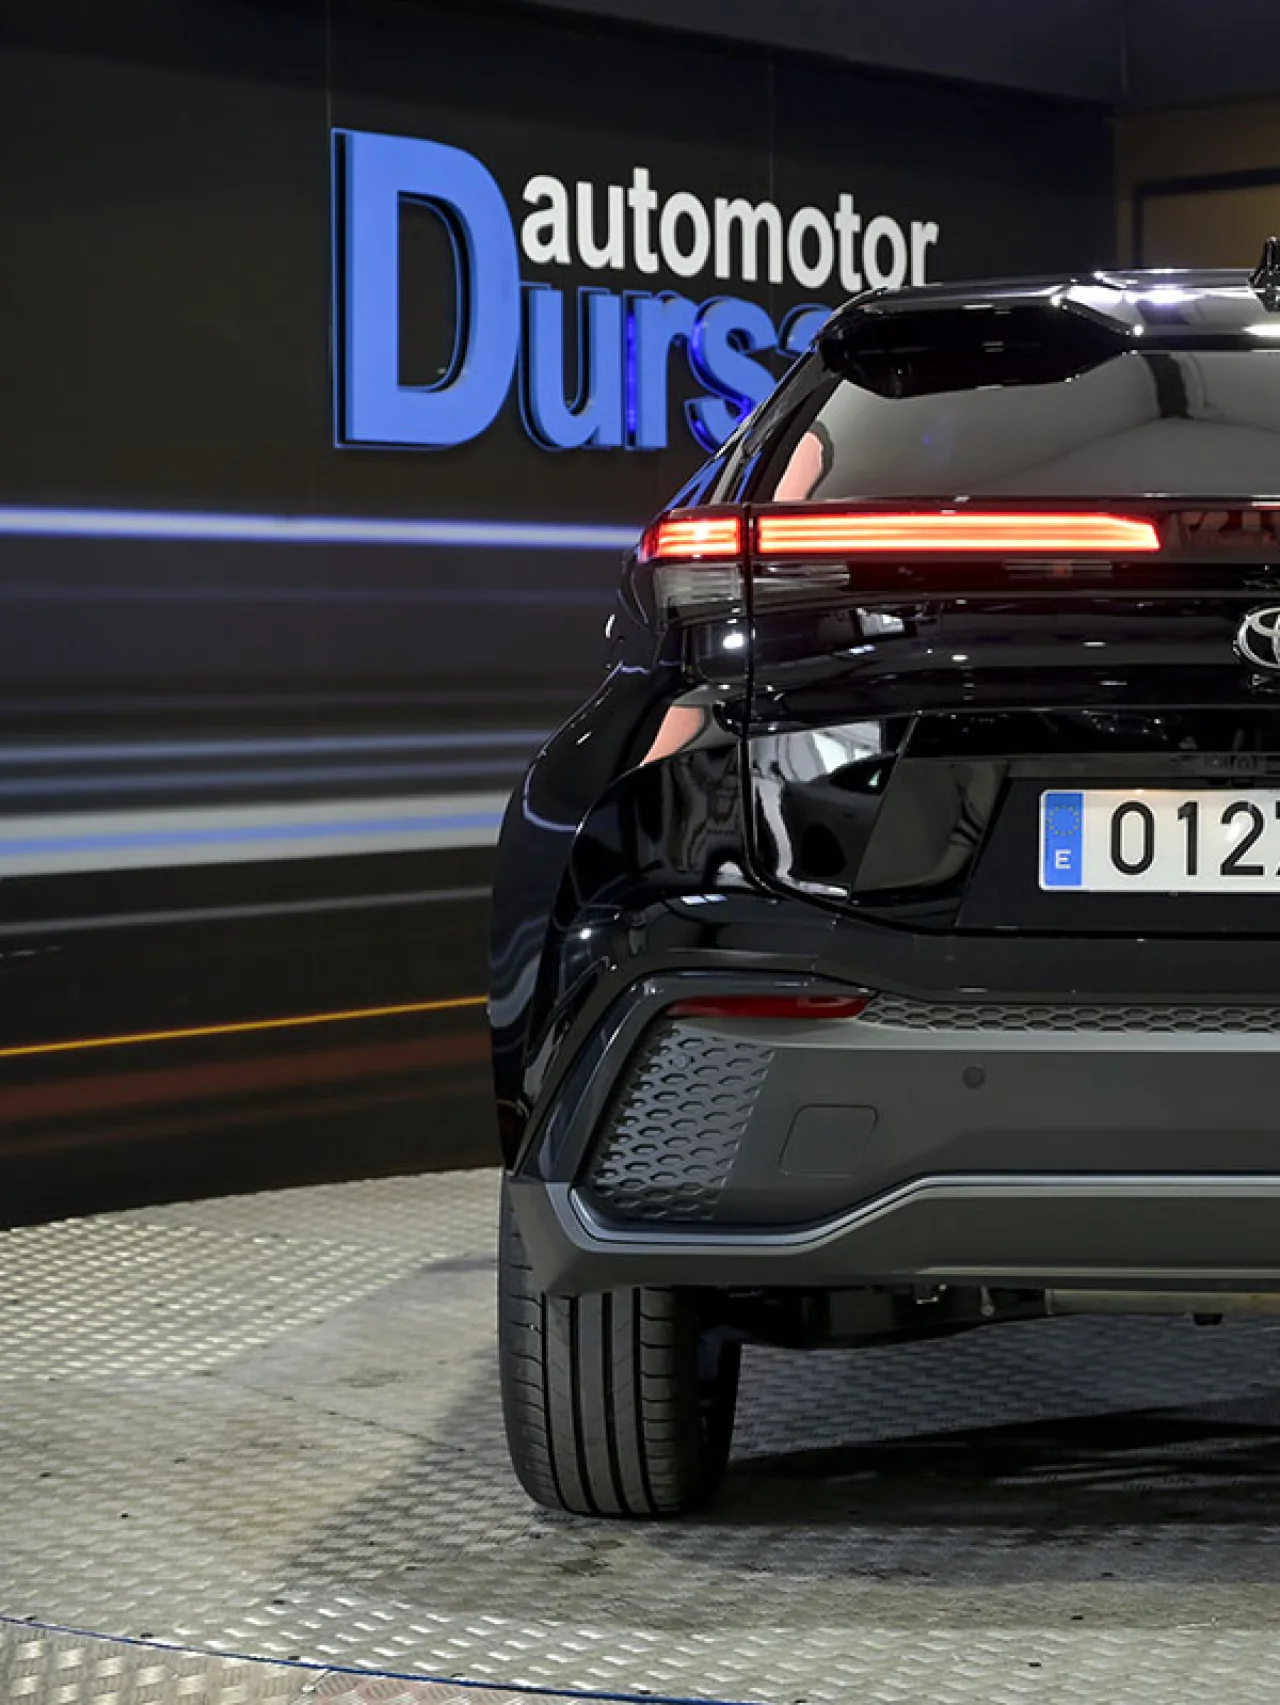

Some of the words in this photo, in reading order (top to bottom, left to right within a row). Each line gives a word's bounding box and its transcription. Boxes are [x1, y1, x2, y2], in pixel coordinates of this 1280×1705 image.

[331, 127, 834, 452] Durs
[521, 167, 939, 293] automotor
[1055, 850, 1072, 869] E
